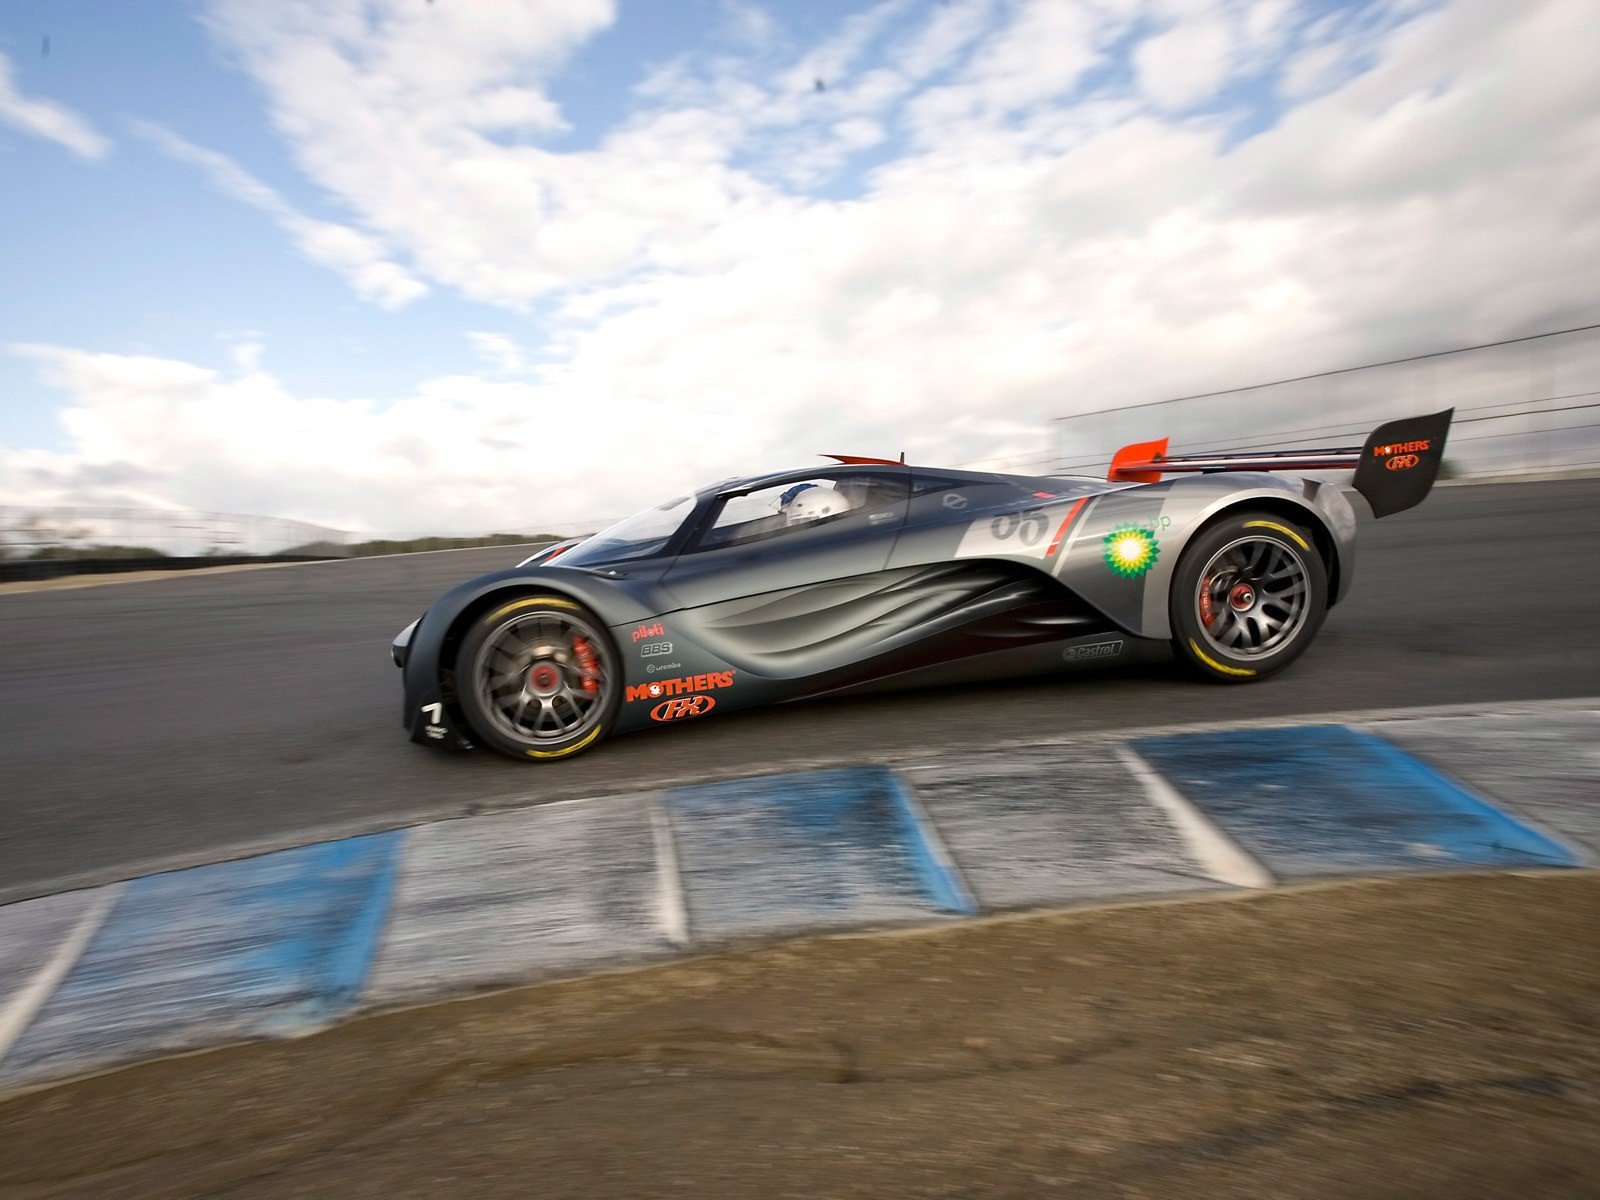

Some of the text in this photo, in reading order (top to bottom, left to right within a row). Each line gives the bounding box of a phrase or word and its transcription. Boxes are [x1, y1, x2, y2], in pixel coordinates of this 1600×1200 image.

[1373, 440, 1430, 457] MOTHERS
[1148, 514, 1171, 531] bp
[632, 624, 665, 643] piloti
[641, 642, 673, 657] BBS
[1077, 643, 1115, 658] Castrol
[626, 670, 734, 702] MOTHERS
